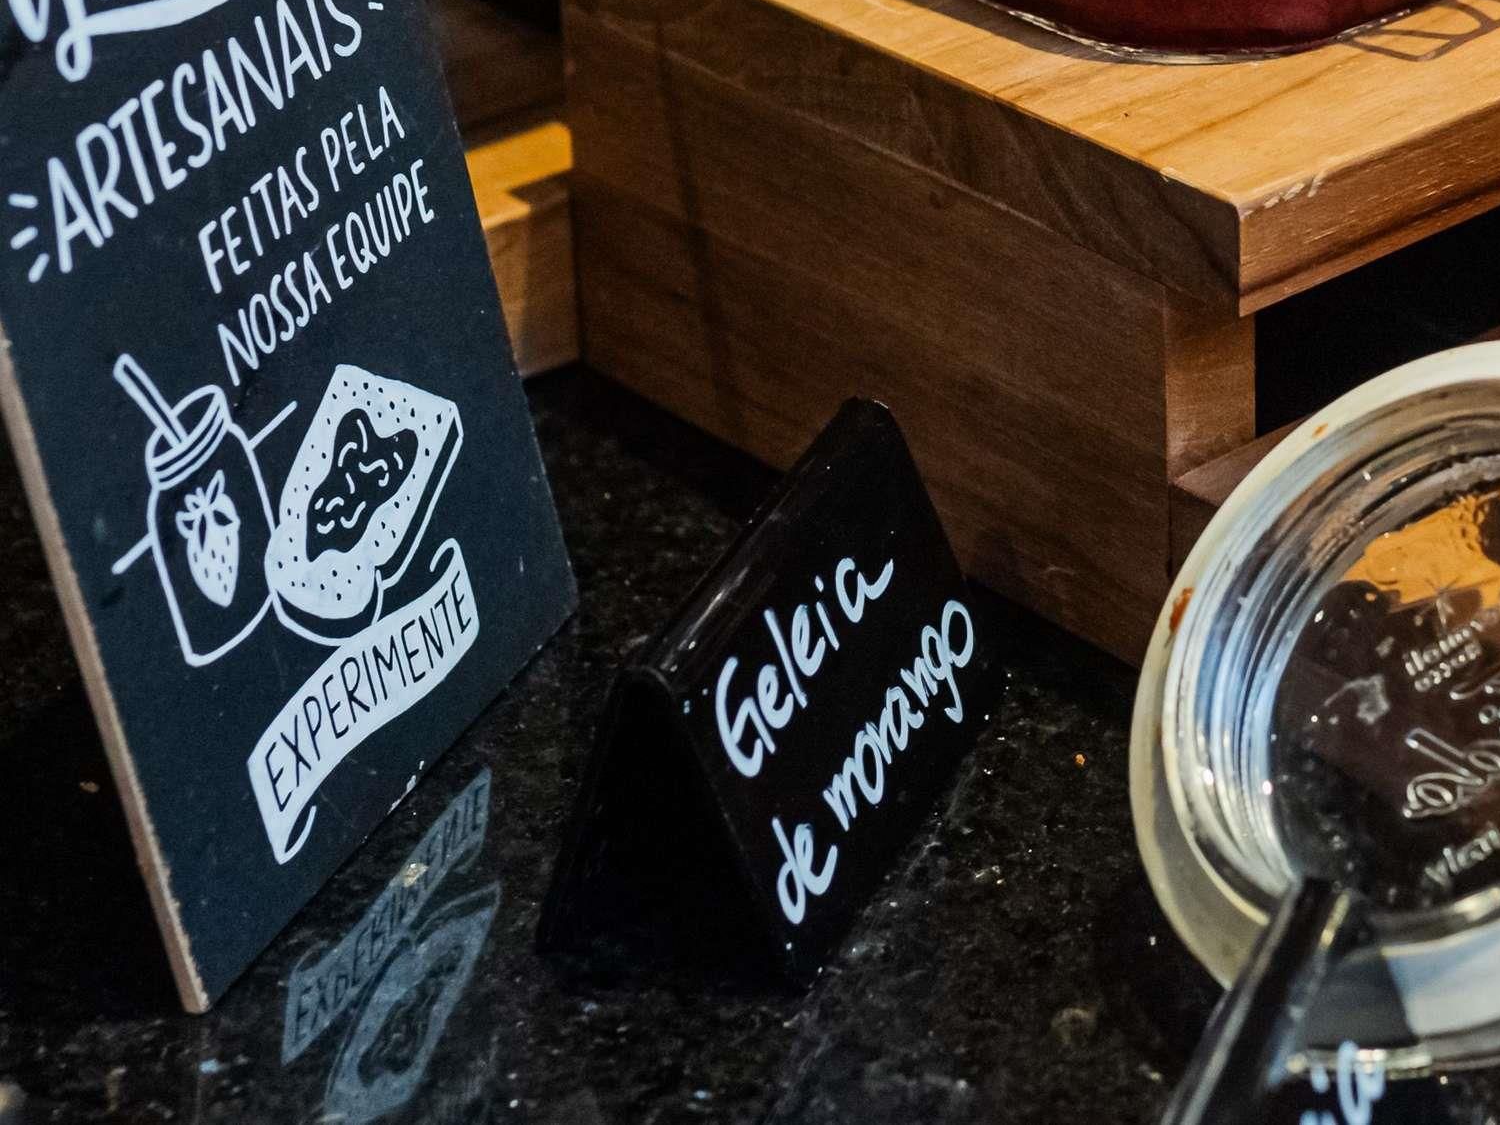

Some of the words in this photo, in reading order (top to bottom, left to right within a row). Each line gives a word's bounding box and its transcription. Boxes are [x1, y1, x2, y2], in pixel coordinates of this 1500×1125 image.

[198, 146, 320, 294] FEITAS
[321, 86, 405, 192] PELA
[217, 251, 333, 388] NOSSA
[325, 158, 435, 290] EQUIPE
[265, 570, 472, 813] EXPERIMENTE
[715, 556, 895, 777] Geleia
[772, 816, 838, 925] de
[823, 599, 974, 832] morango
